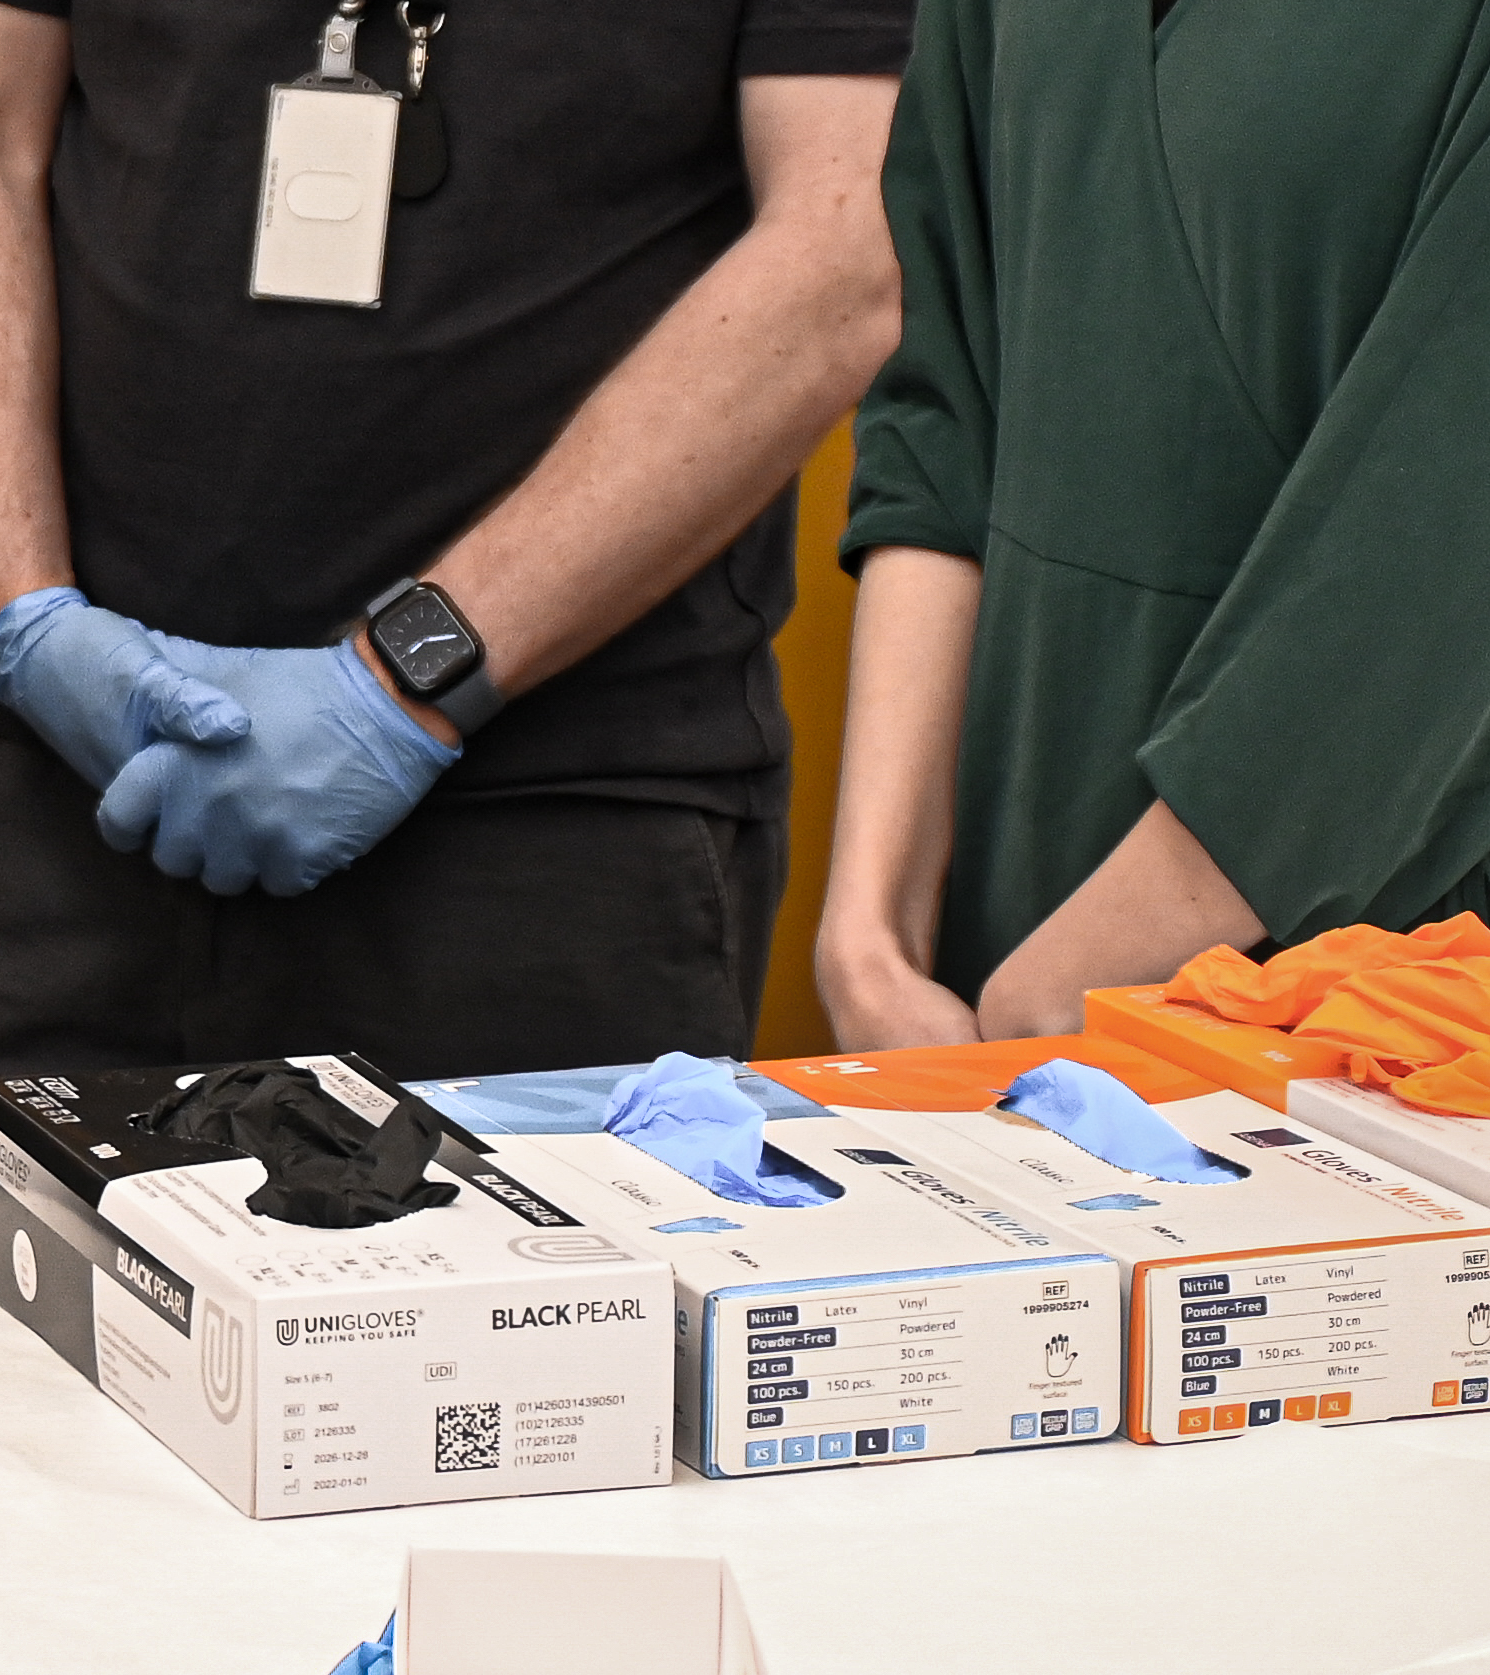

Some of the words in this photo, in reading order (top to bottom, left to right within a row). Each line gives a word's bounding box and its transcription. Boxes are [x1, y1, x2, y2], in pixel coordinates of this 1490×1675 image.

[1302, 1150, 1382, 1183] Gloves
[1382, 1186, 1465, 1221] Nitrile
[902, 1170, 976, 1205] Gloves
[972, 1210, 1050, 1247] Nitrile
[1465, 1253, 1487, 1265] REF
[116, 1246, 154, 1297] BLACK
[152, 1275, 187, 1323] PEARL
[1044, 1284, 1067, 1296] REF
[1183, 1279, 1225, 1293] Nitrile
[1255, 1275, 1287, 1286] Latex
[1326, 1265, 1354, 1279] Vinyl
[492, 1304, 572, 1330] BLACK
[577, 1298, 646, 1324] PEARL
[750, 1312, 794, 1325] Nitrile
[825, 1306, 858, 1317] Latex
[899, 1297, 928, 1311] Vinyl
[1023, 1300, 1089, 1315] 1999905274
[1185, 1301, 1262, 1318] Powder-Free
[1327, 1289, 1382, 1303] Powdered
[305, 1334, 356, 1344] KEEPING
[361, 1331, 384, 1341] YOU
[389, 1329, 416, 1338] SAFE
[751, 1332, 832, 1350] Powder-Free
[900, 1319, 956, 1334] Powdered
[1186, 1331, 1201, 1343] 24
[1204, 1331, 1221, 1342] cm
[1328, 1317, 1343, 1328] 30
[1345, 1316, 1361, 1326] cm
[752, 1363, 767, 1375] 24
[770, 1363, 788, 1373] cm
[900, 1348, 915, 1360] 30
[918, 1347, 934, 1357] cm
[1187, 1355, 1209, 1367] 100
[1211, 1354, 1235, 1367] pcs.
[1258, 1348, 1279, 1360] 150
[1282, 1347, 1305, 1360] pcs.
[1328, 1341, 1351, 1353] 200
[1354, 1339, 1377, 1352] pcs.
[429, 1366, 453, 1378] UDI
[752, 1388, 775, 1399] 100
[778, 1387, 802, 1400] pcs.
[827, 1379, 849, 1391] 150
[852, 1379, 875, 1391] pcs.
[900, 1372, 923, 1384] 200
[927, 1371, 952, 1383] pcs.
[1185, 1379, 1210, 1392] Blue
[1327, 1365, 1360, 1376] White
[751, 1412, 777, 1424] Blue
[900, 1397, 934, 1409] White
[1187, 1415, 1202, 1427] XS
[1225, 1413, 1233, 1424] S
[1258, 1407, 1271, 1419] M
[1295, 1405, 1303, 1416] L
[1327, 1401, 1341, 1412] XL
[314, 1425, 356, 1438] 2126335
[753, 1447, 769, 1457] XS
[794, 1445, 803, 1456] S
[829, 1441, 842, 1453] M
[868, 1437, 877, 1449] L
[901, 1434, 918, 1446] XL
[514, 1452, 576, 1467] (11)220101
[314, 1477, 368, 1490] 2022-01-01
